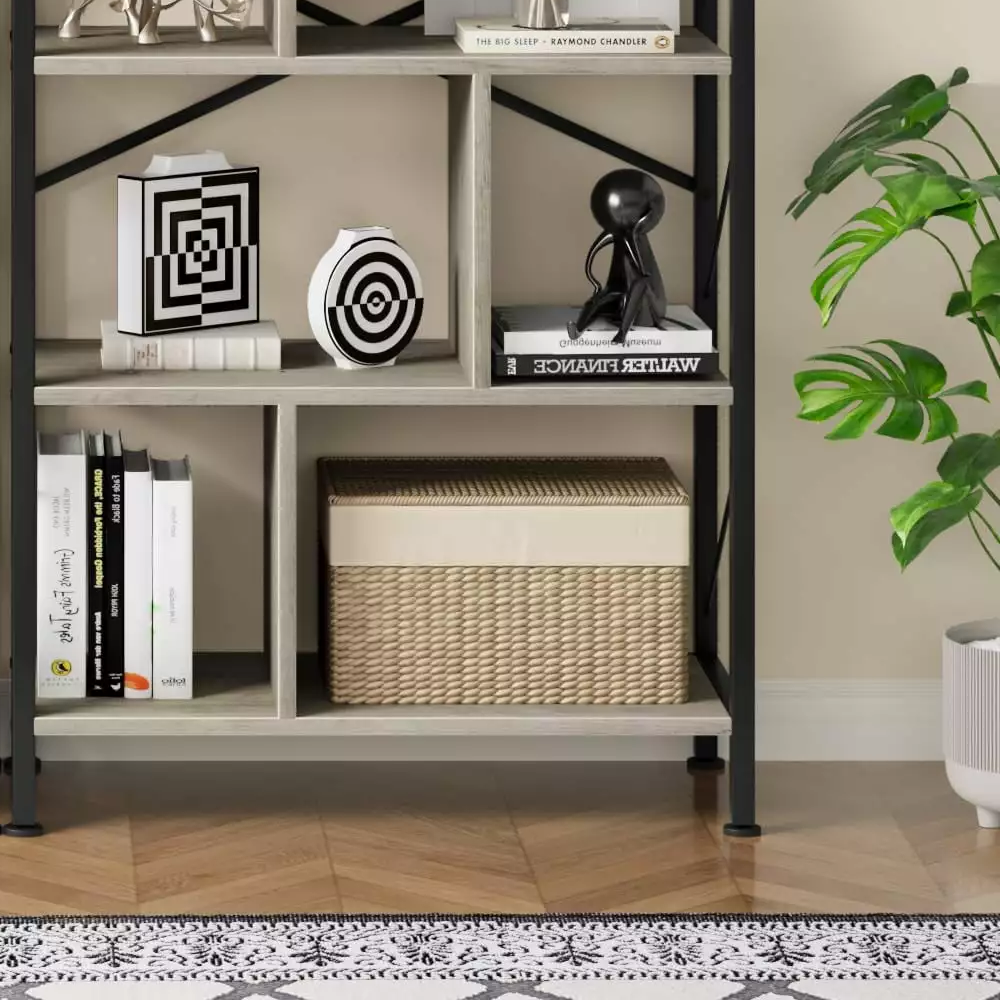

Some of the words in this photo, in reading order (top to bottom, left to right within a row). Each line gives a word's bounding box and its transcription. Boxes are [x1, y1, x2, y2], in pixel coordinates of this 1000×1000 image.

[476, 38, 492, 46] THE
[495, 38, 511, 46] BIG
[514, 38, 539, 46] SLEEP
[550, 38, 597, 46] RAYMOND
[600, 38, 647, 46] CHANDLER
